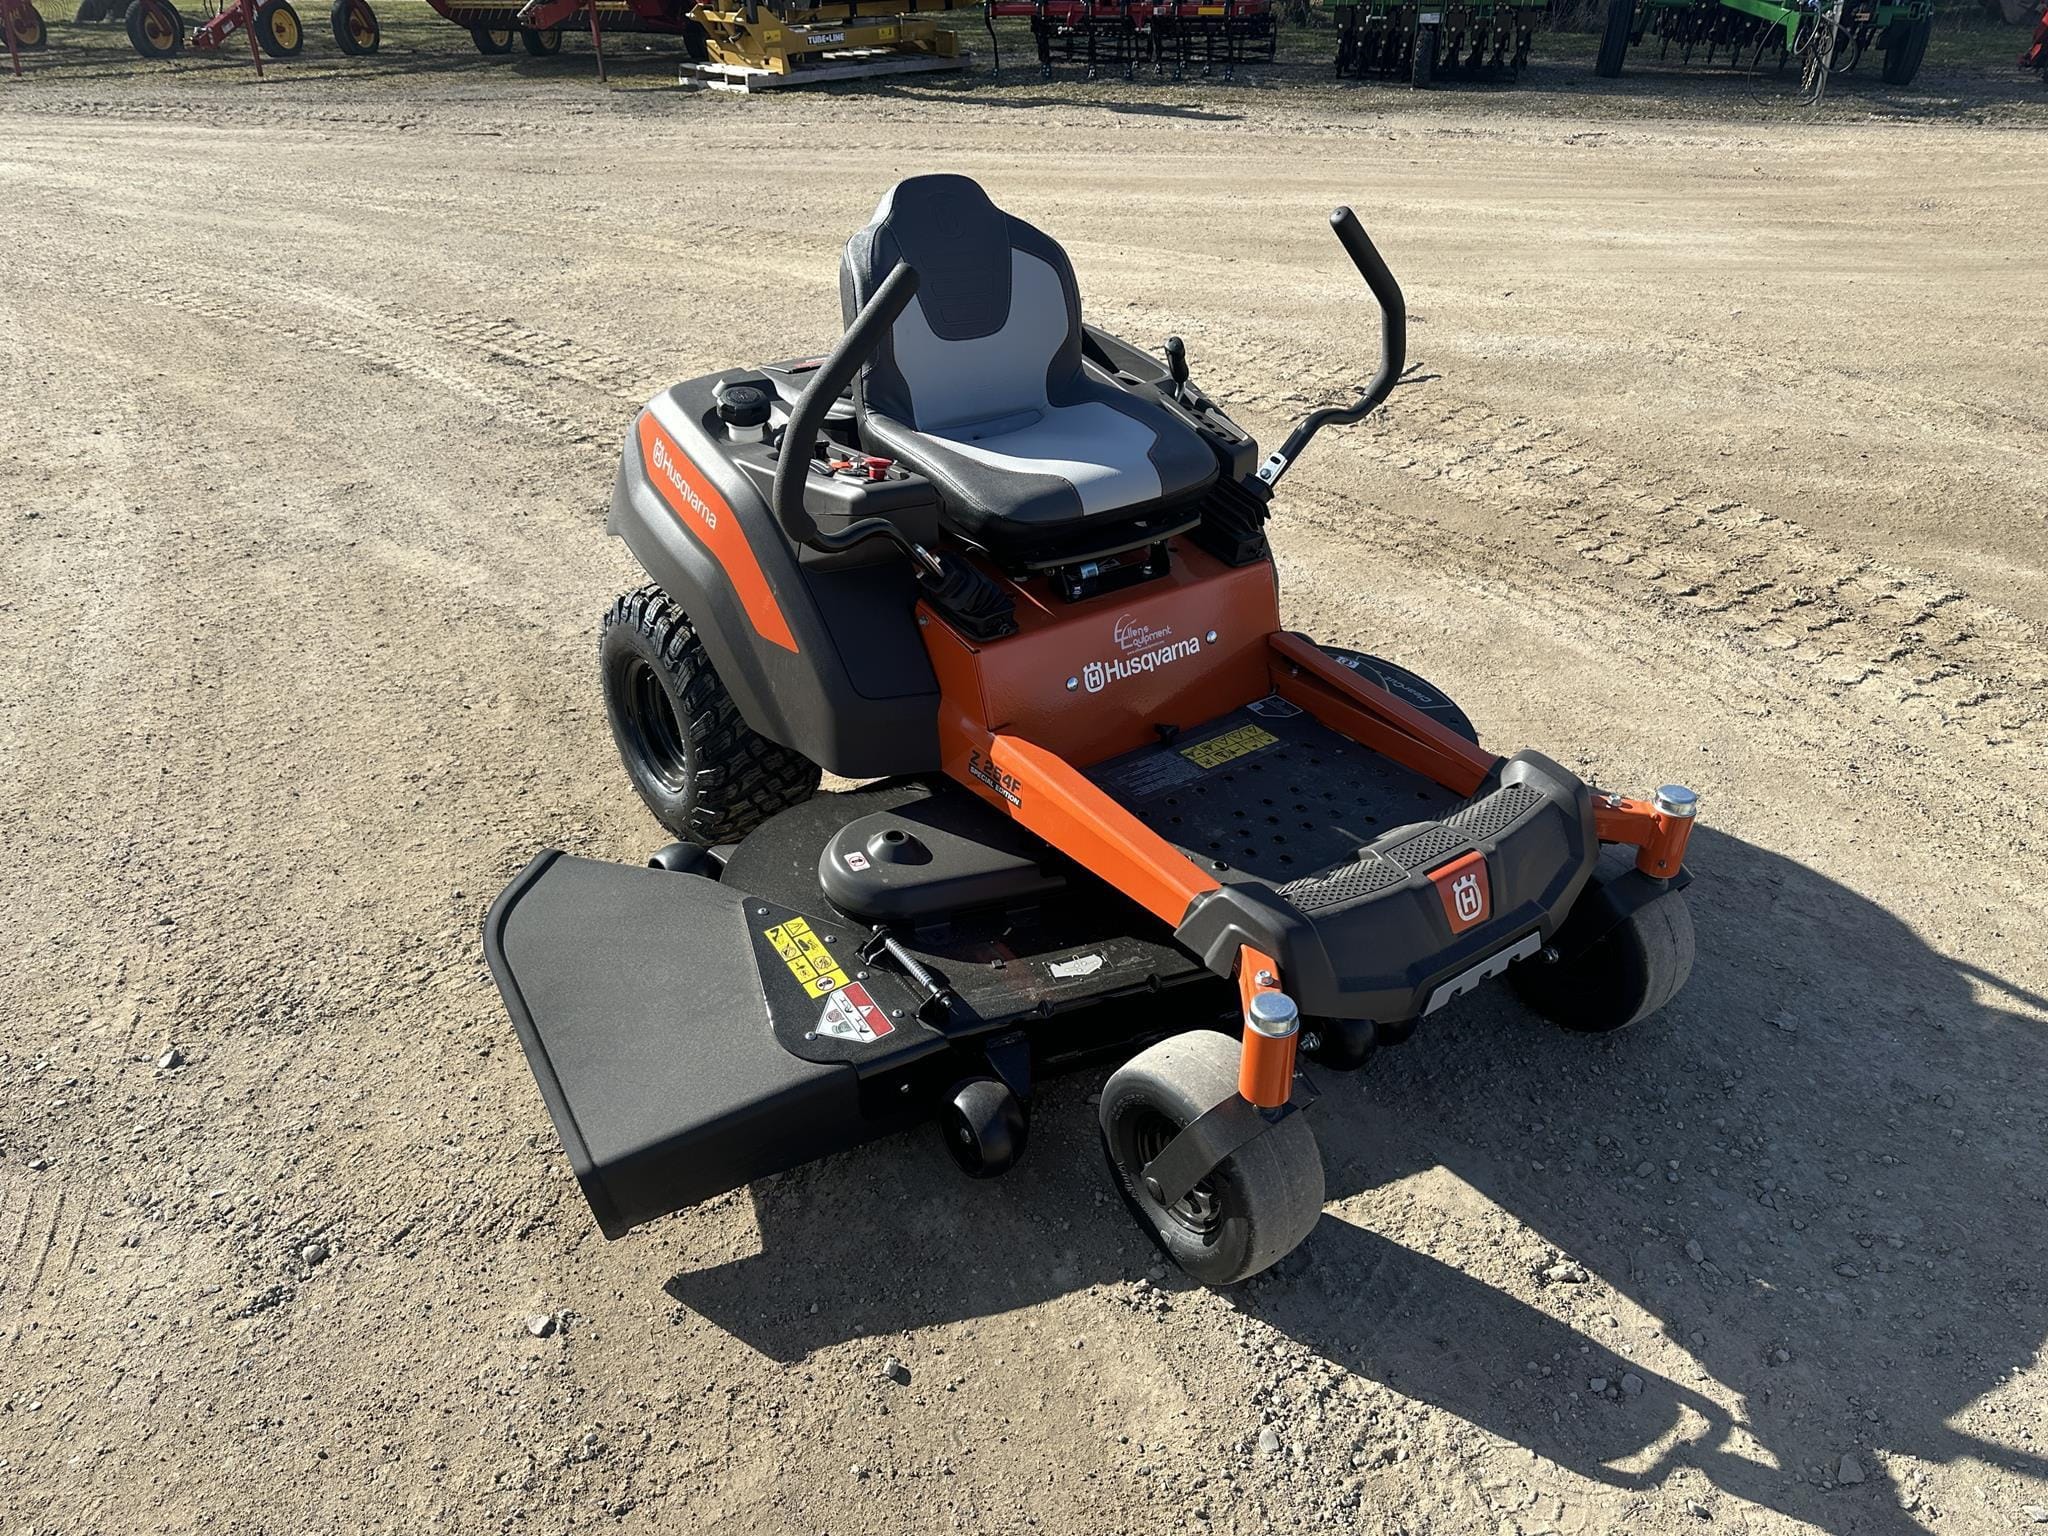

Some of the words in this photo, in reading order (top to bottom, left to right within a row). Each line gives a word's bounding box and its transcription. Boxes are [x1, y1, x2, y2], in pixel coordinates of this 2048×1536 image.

[662, 452, 717, 530] Husqvarna
[1120, 619, 1173, 650] Equipment
[1104, 637, 1200, 683] Husqvarna
[970, 750, 980, 767] Z
[984, 760, 1021, 792] 254F
[970, 766, 995, 788] SPECIAL
[995, 784, 1020, 806] EDITION
